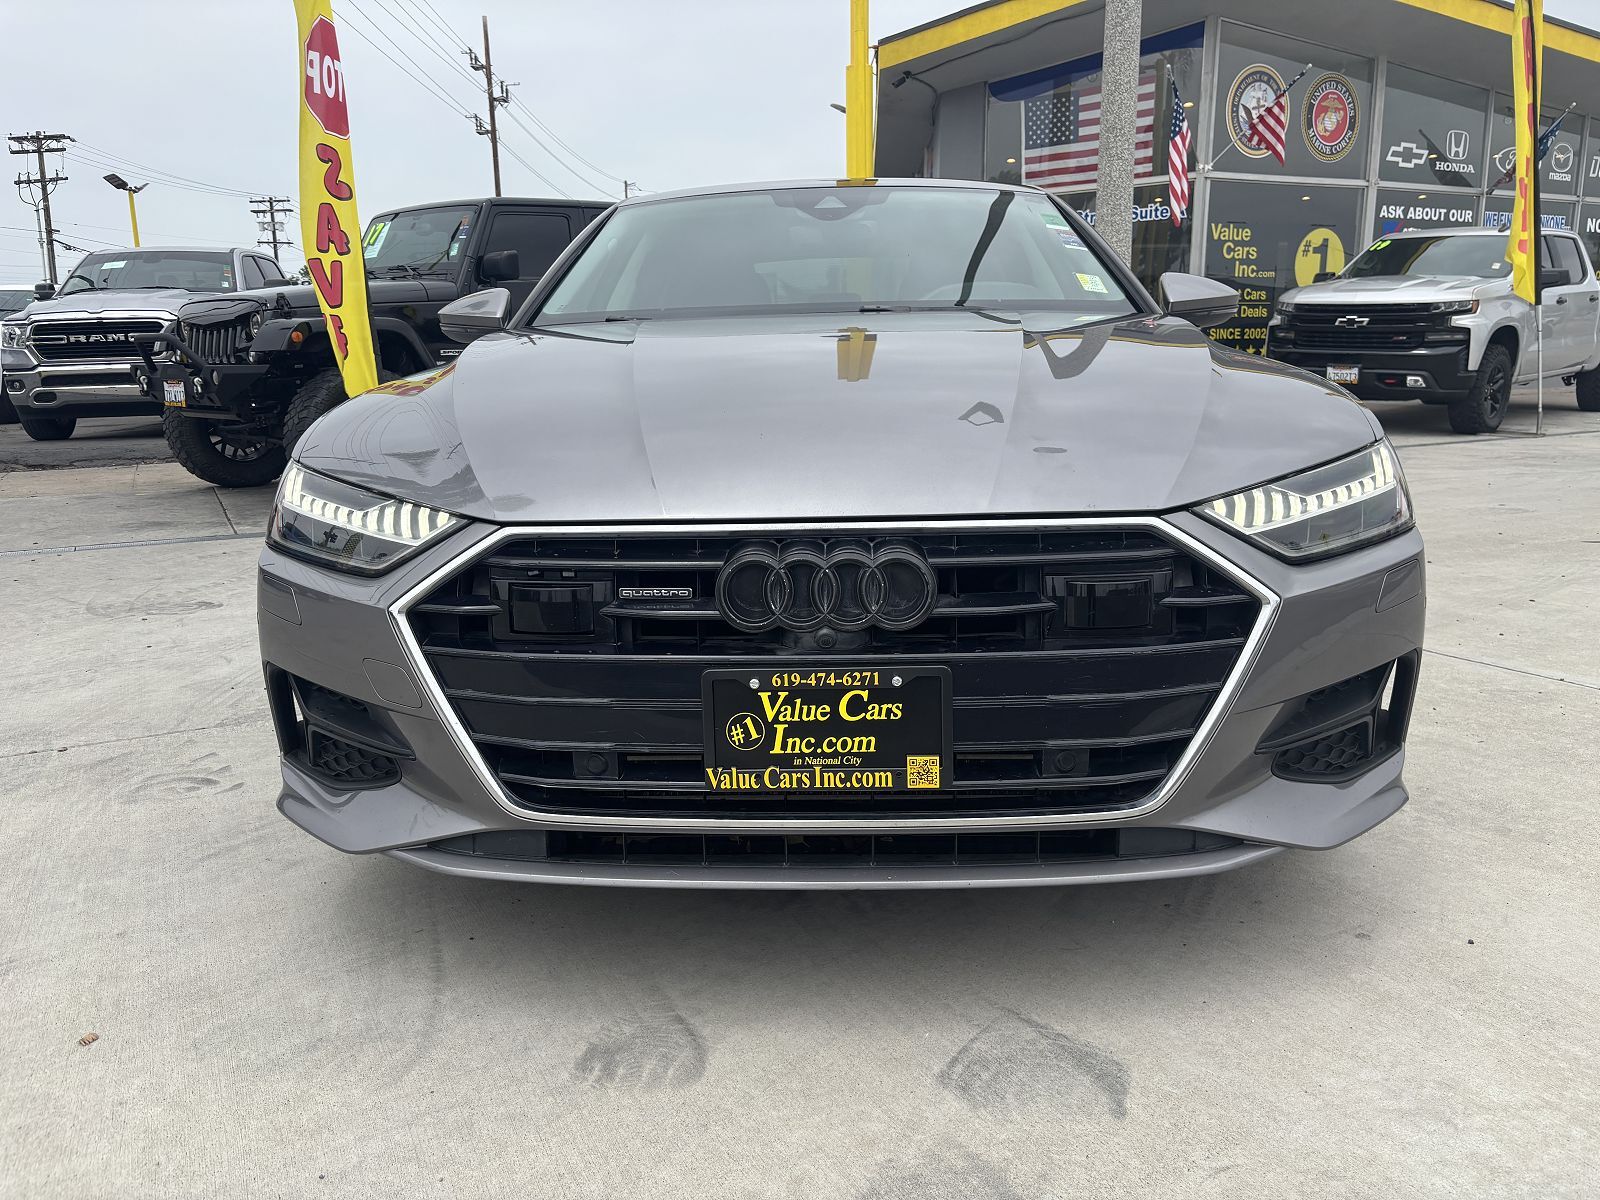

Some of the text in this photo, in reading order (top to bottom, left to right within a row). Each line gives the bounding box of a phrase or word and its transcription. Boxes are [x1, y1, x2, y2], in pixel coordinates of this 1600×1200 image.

[1310, 81, 1354, 117] UNITED STATES
[1308, 127, 1353, 154] MARINE CORPS
[1435, 161, 1475, 173] HONDA
[1549, 172, 1571, 181] mazda
[1132, 203, 1170, 223] Suite
[1379, 205, 1472, 222] ASK ABOUT OUR
[1484, 211, 1498, 228] WE
[364, 222, 386, 248] 17
[1211, 223, 1251, 241] Value
[1223, 242, 1257, 259] Cars
[1302, 237, 1329, 273] #1
[1234, 260, 1276, 278] Inc.com
[1243, 288, 1266, 301] Cars
[1241, 305, 1267, 318] Deals
[69, 333, 126, 343] RAM
[1209, 327, 1267, 341] SINCE 2002
[622, 589, 689, 598] quattro
[771, 671, 880, 687] 619-474-6271
[758, 689, 903, 723] Value Cars
[730, 716, 762, 746] #1
[769, 723, 877, 755] Inc.com
[793, 755, 862, 767] in National City
[763, 765, 811, 789] Cars
[813, 766, 893, 788] Inc.com
